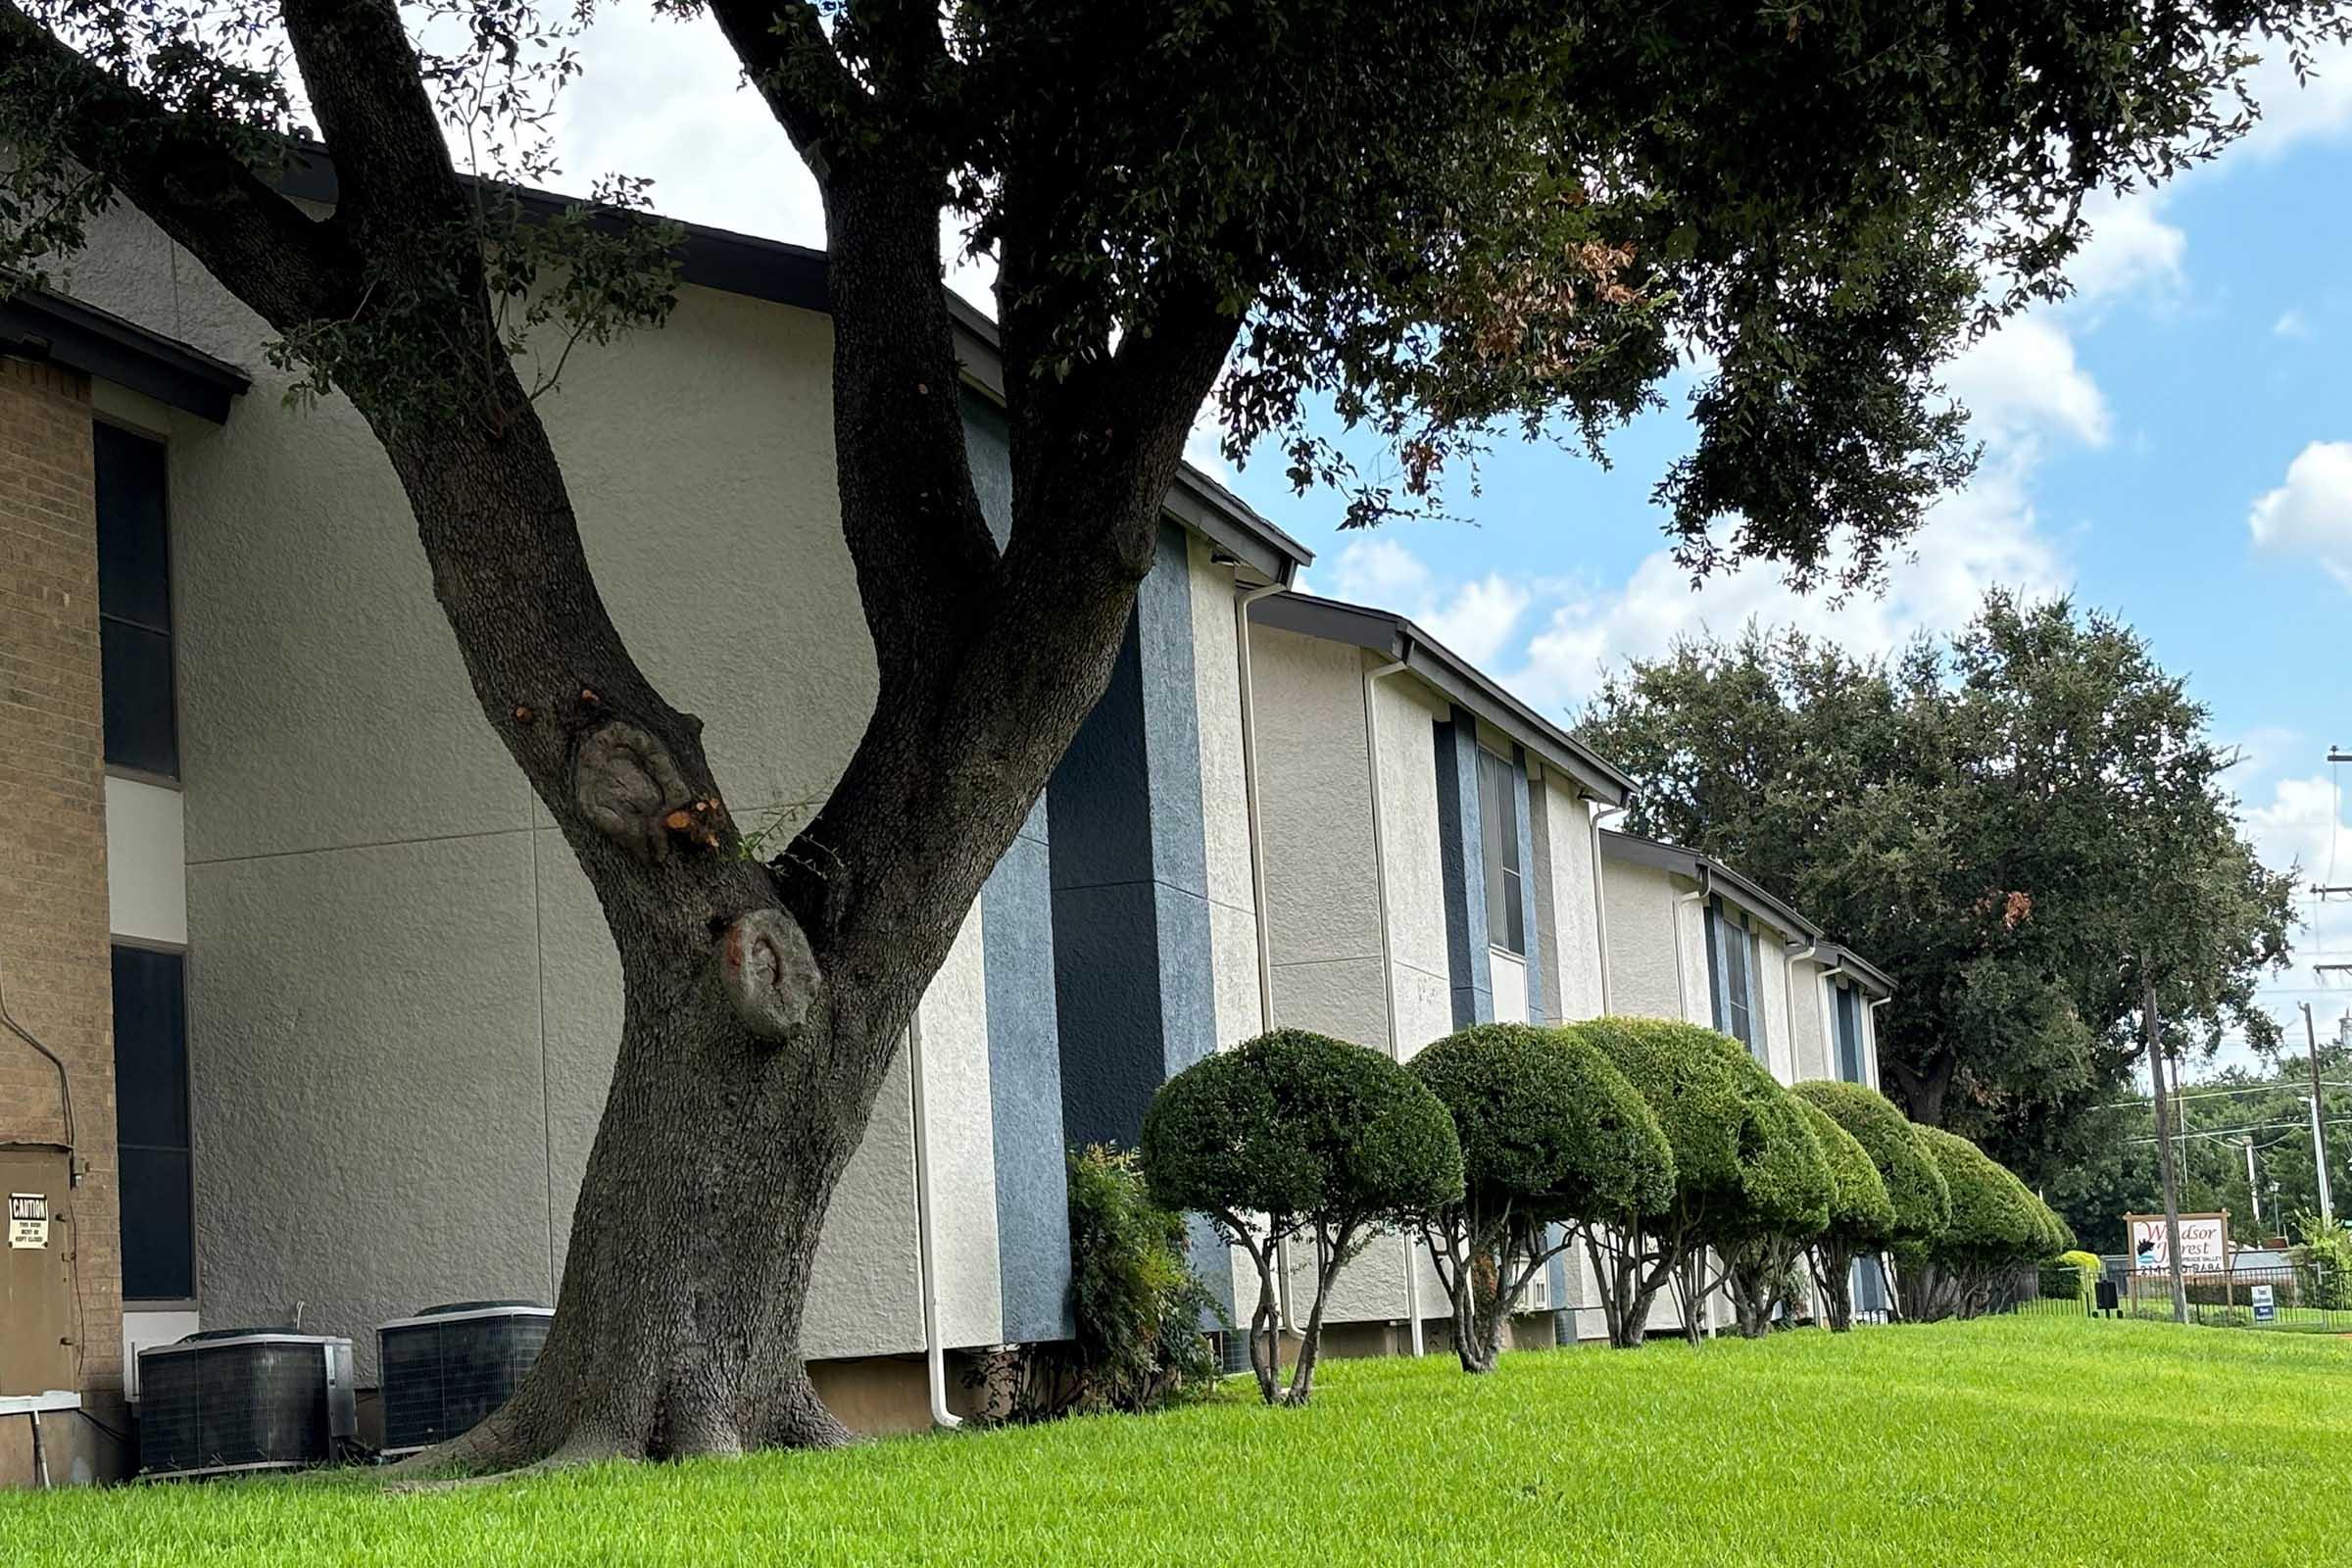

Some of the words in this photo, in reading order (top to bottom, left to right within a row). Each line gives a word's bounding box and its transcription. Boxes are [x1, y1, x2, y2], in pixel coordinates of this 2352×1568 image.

[13, 1200, 45, 1218] CAUTION
[2144, 1222, 2217, 1241] Wdsor
[2154, 1242, 2209, 1263] Frest
